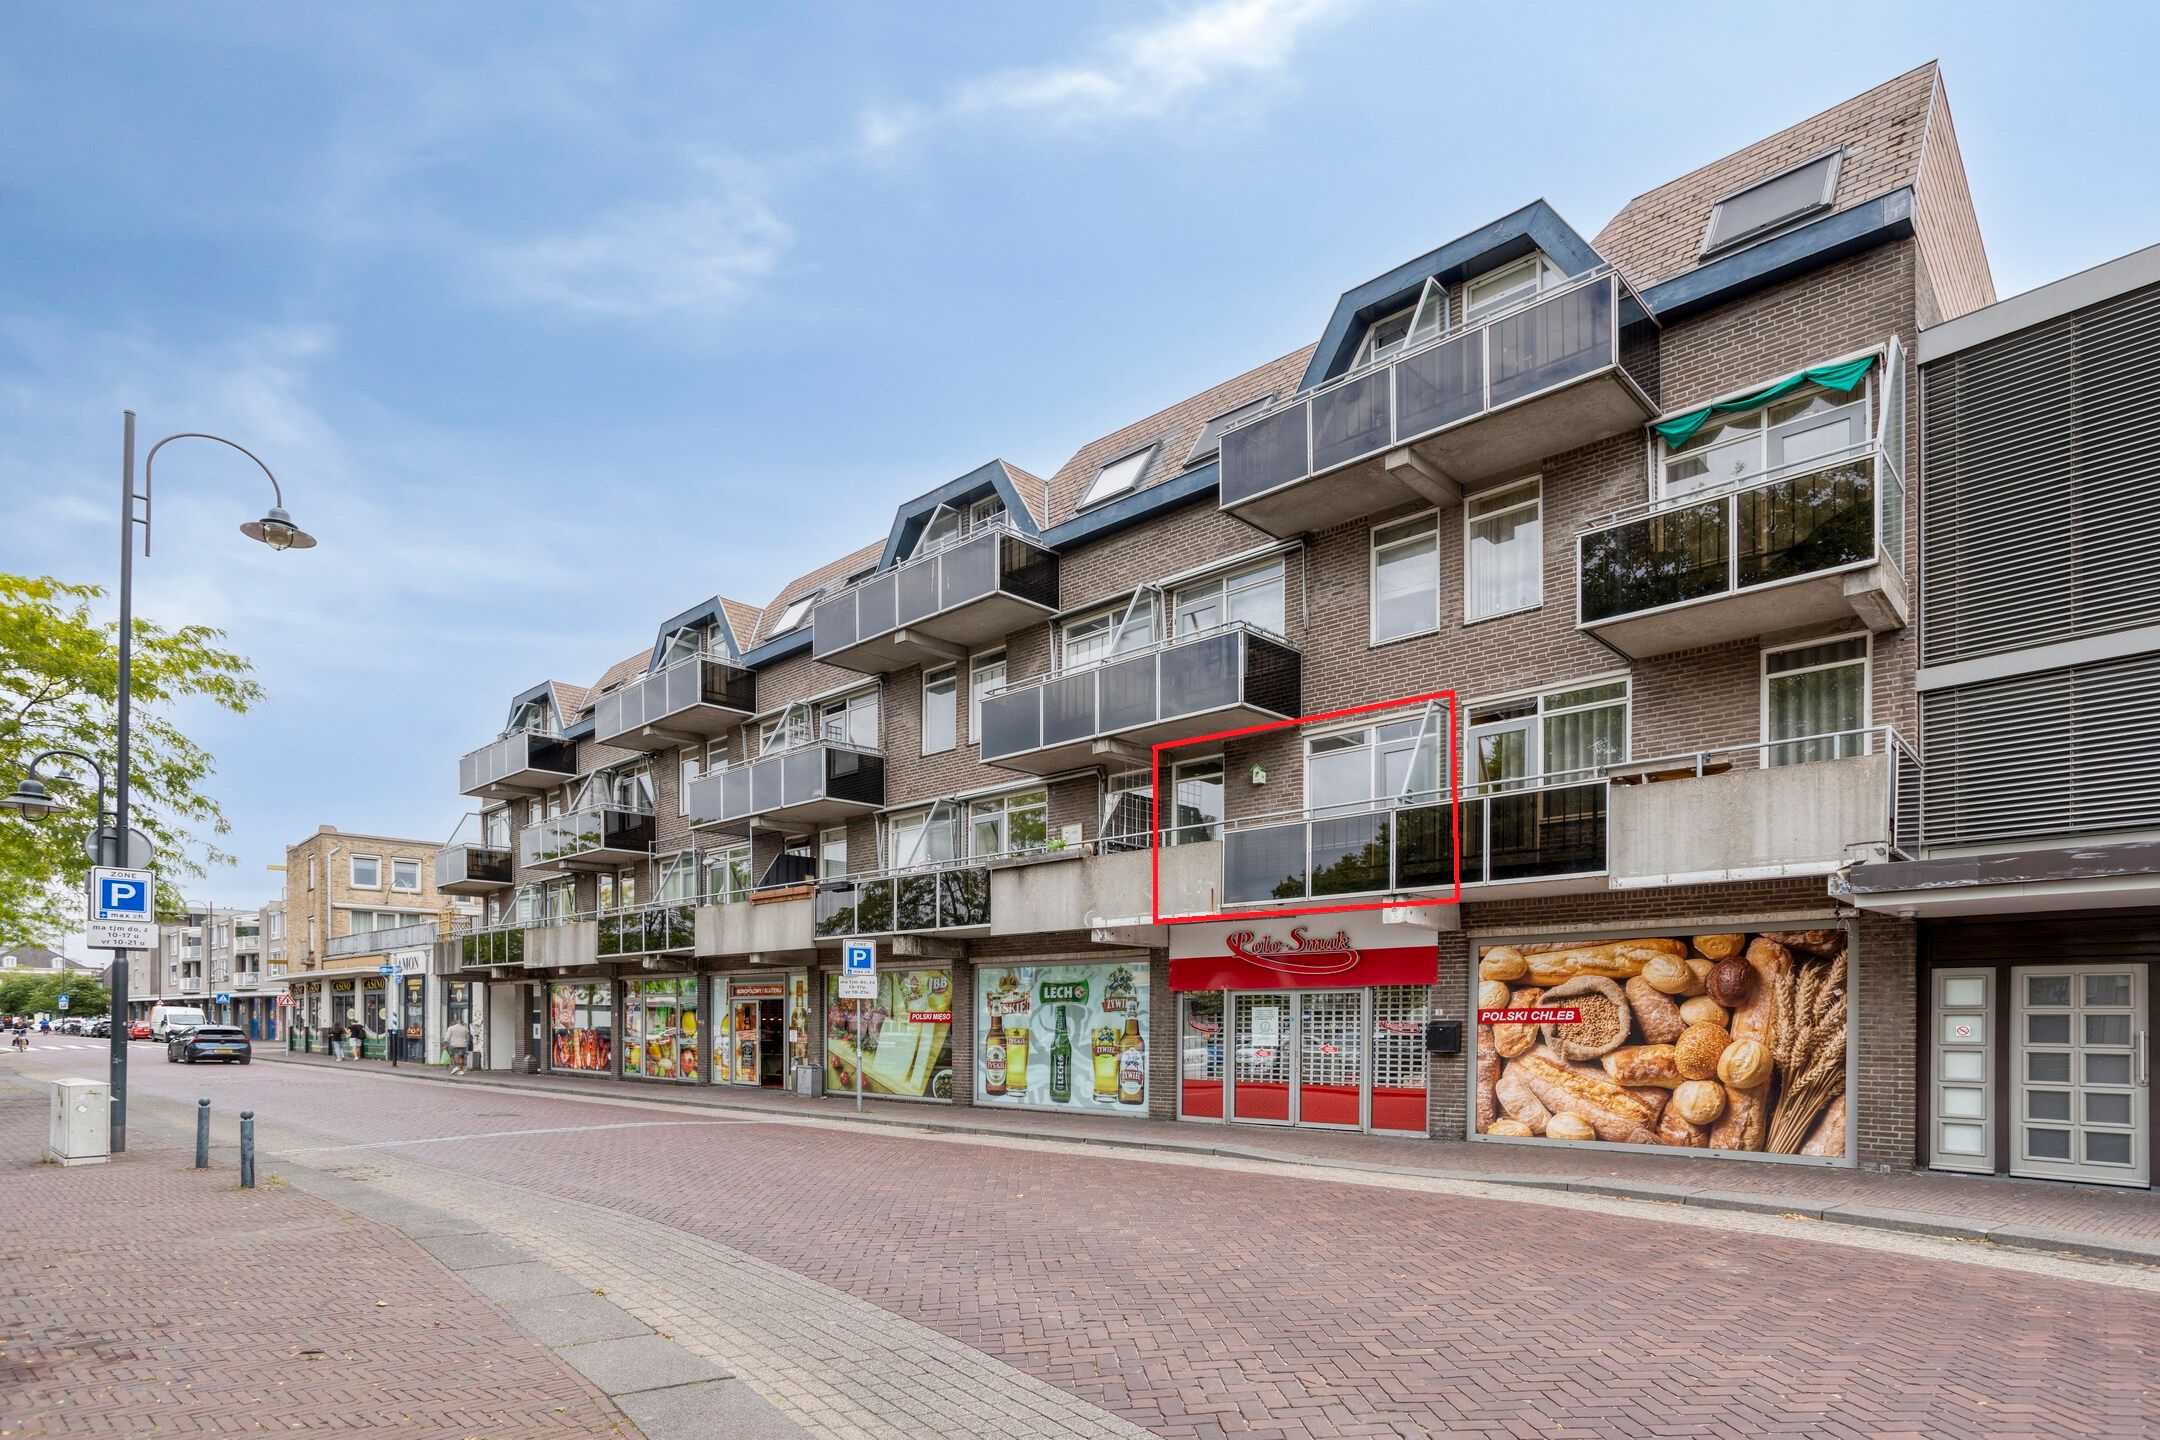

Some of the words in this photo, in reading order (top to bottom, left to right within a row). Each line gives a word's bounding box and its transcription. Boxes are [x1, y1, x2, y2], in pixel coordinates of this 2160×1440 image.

[111, 883, 136, 907] P
[853, 950, 867, 966] P
[364, 979, 385, 990] CASINO
[927, 976, 947, 996] JBB
[1044, 986, 1072, 999] LECH
[933, 1013, 951, 1021] MIĘSO
[1481, 1011, 1528, 1021] POLSKI
[1530, 1010, 1575, 1021] CHLEB
[987, 1061, 1005, 1069] TYSKIE
[1057, 1066, 1065, 1086] LECH
